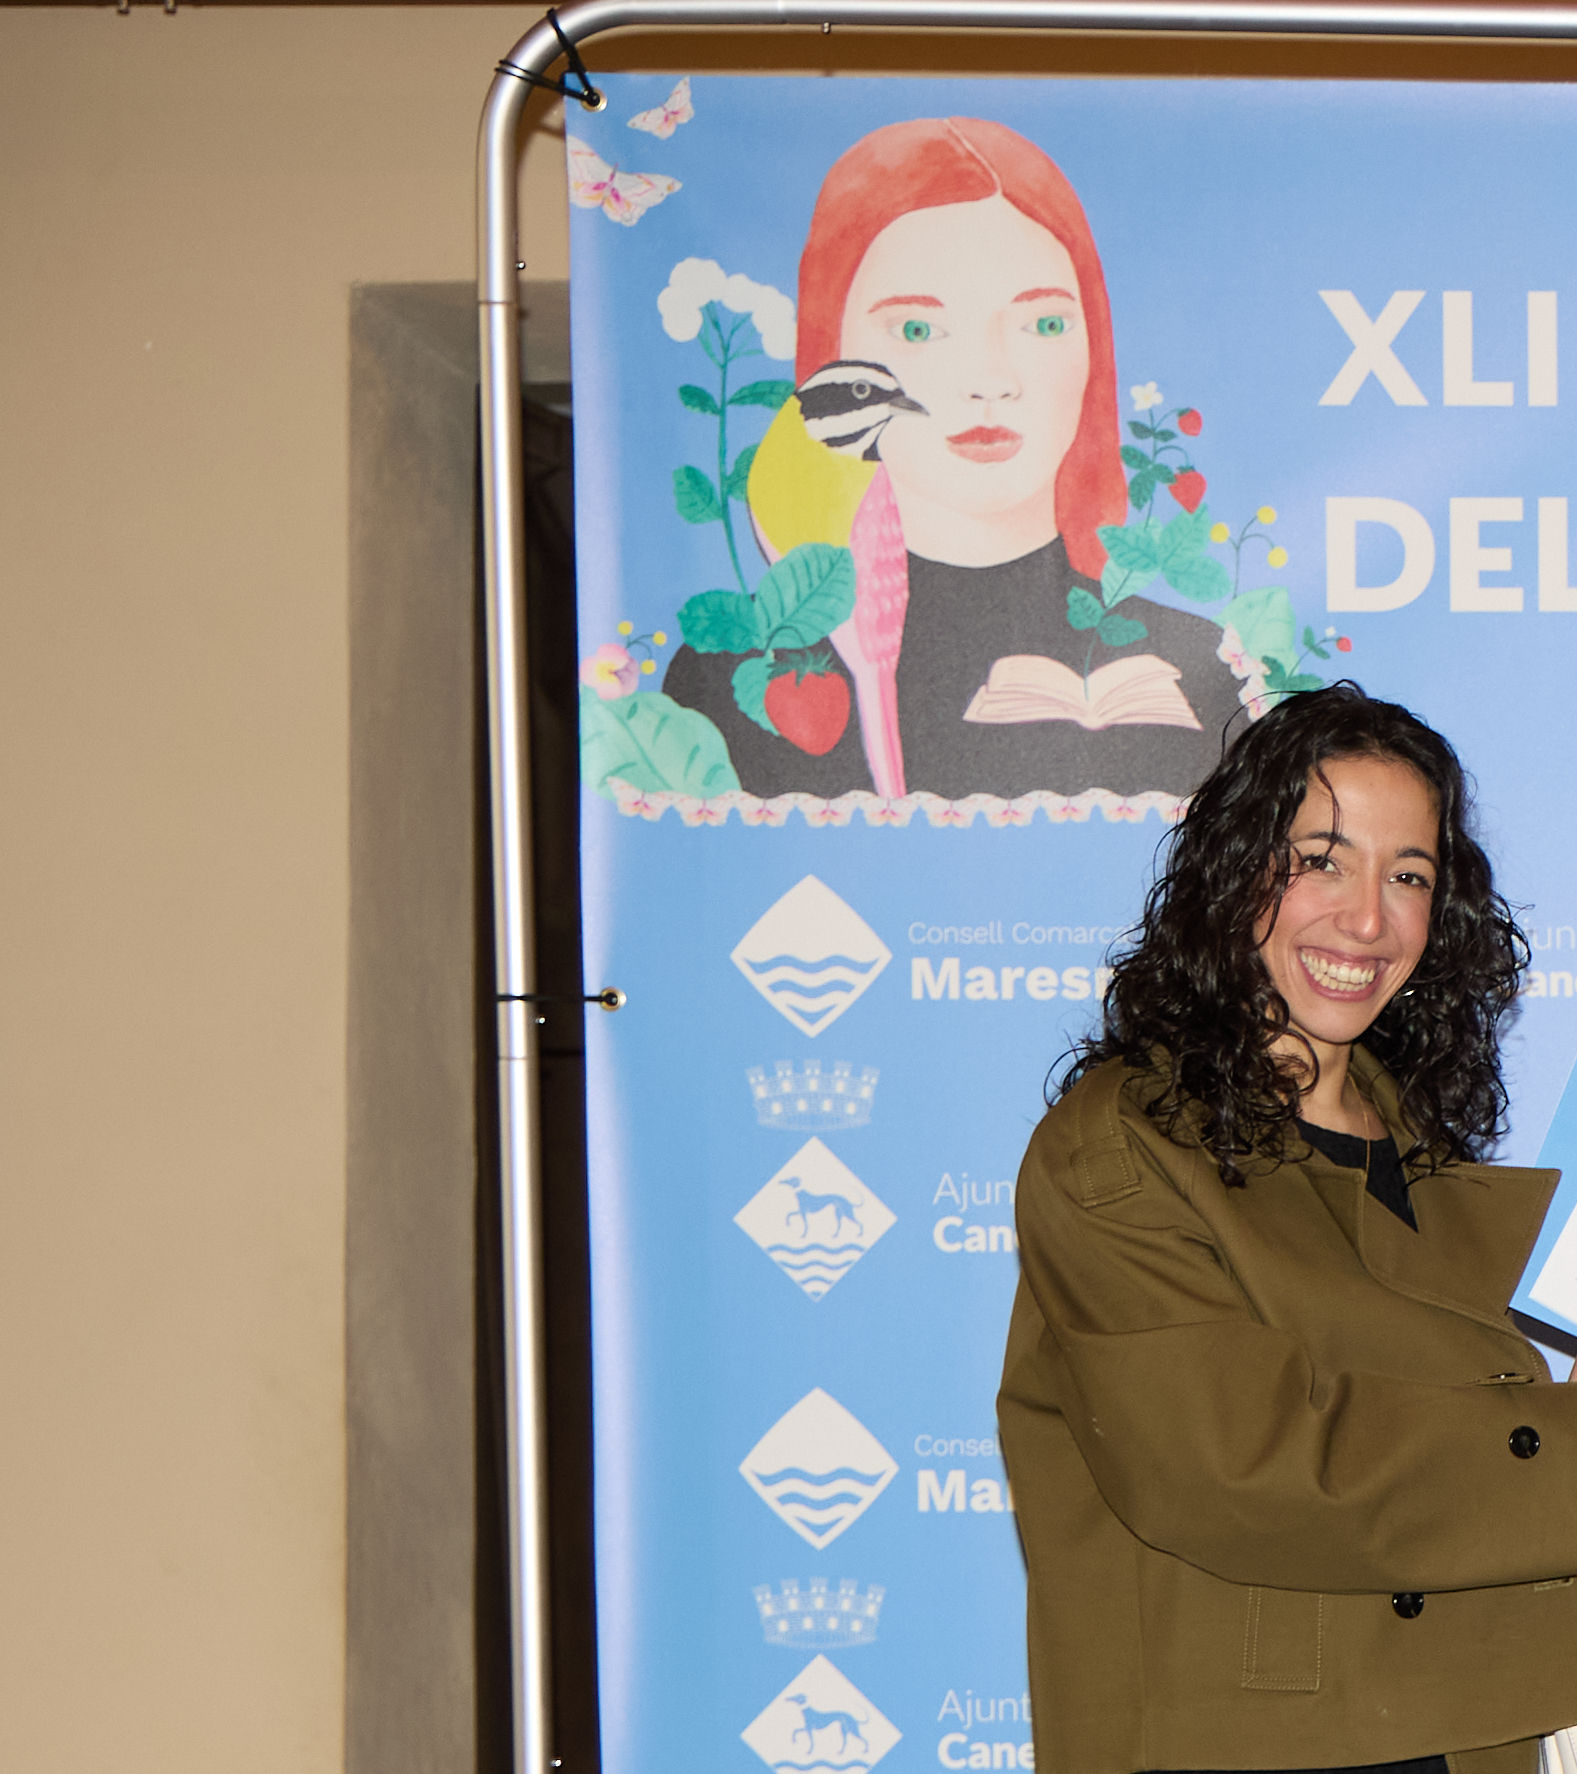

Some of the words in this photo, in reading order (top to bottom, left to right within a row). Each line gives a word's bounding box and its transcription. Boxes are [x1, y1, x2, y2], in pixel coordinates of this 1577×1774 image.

[908, 921, 1003, 944] Consell
[910, 956, 1113, 1000] Mares
[938, 1733, 1035, 1770] Cane
